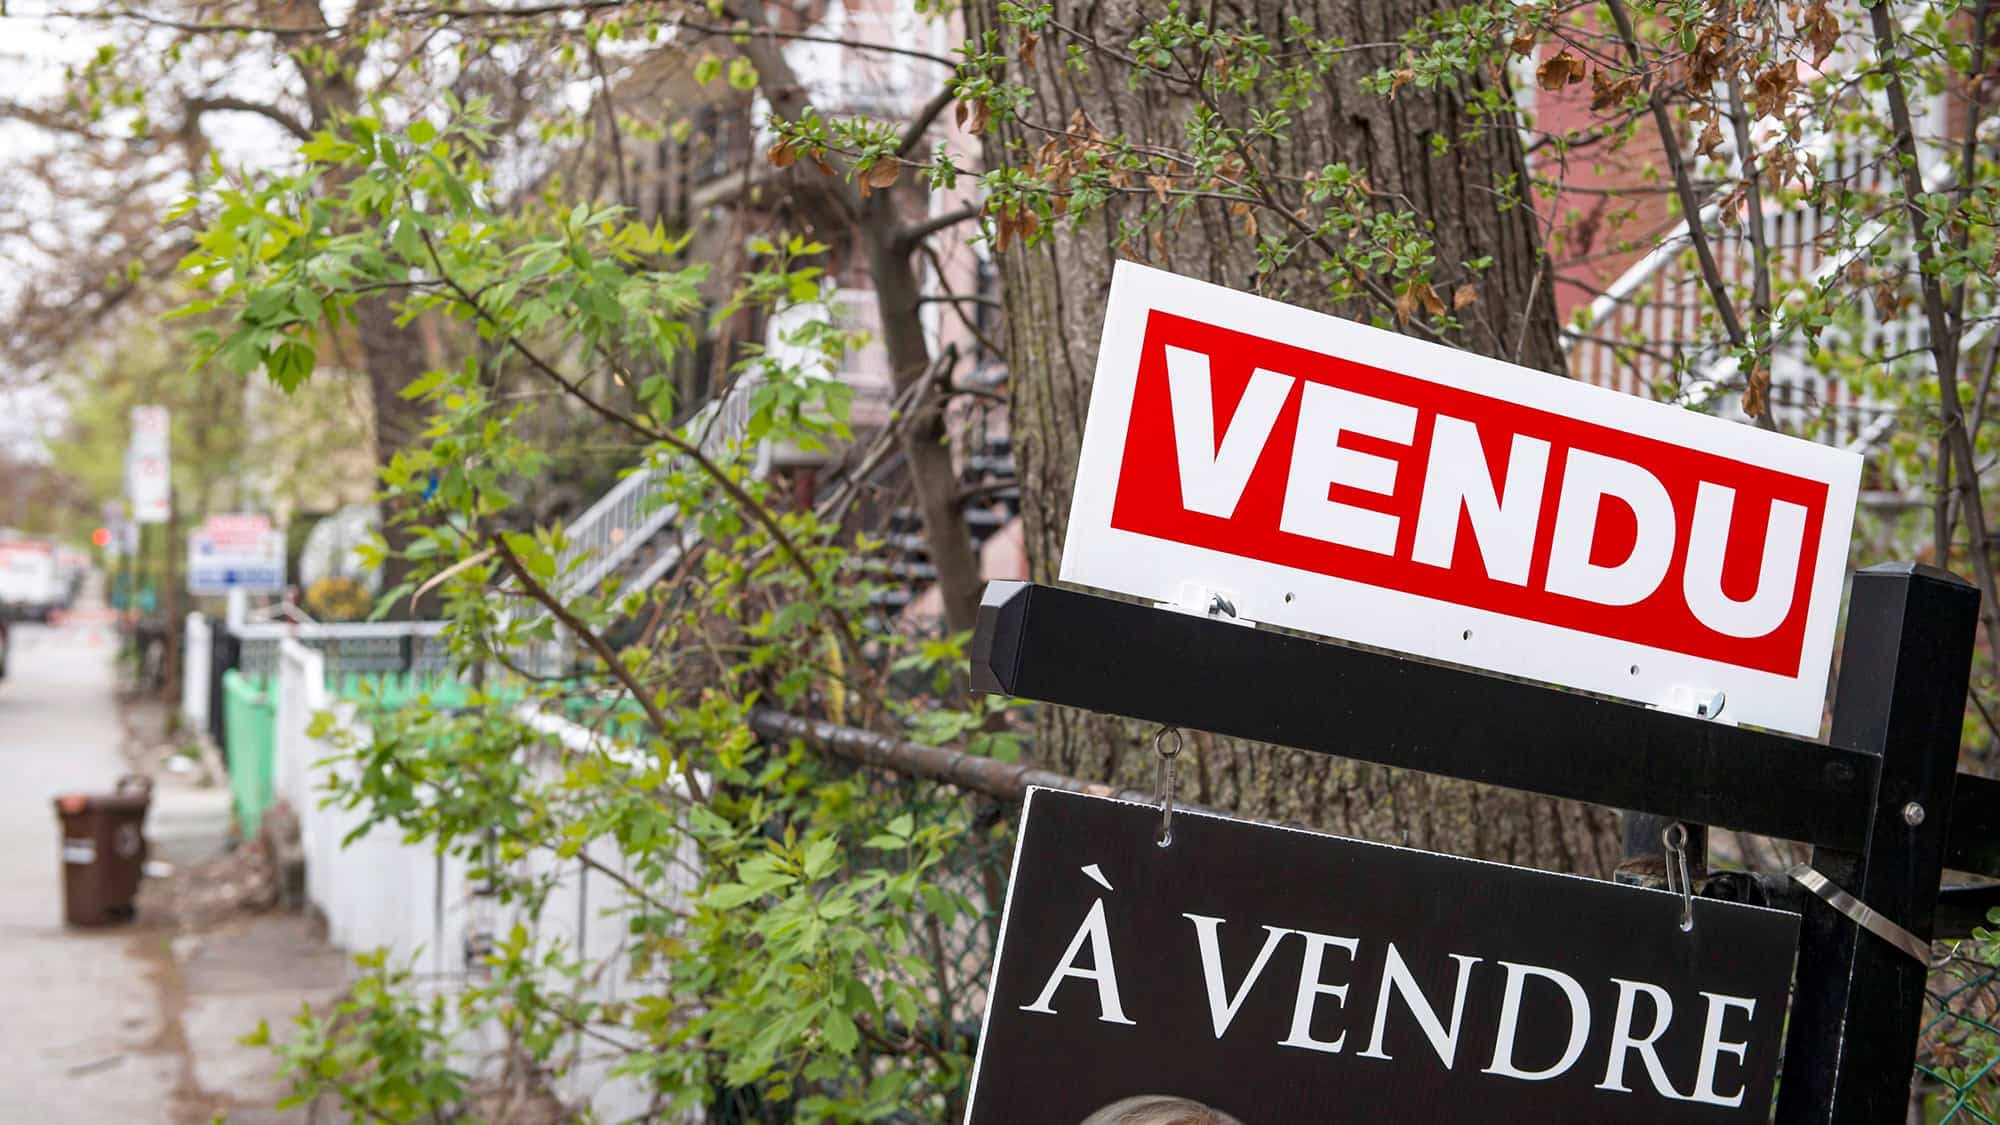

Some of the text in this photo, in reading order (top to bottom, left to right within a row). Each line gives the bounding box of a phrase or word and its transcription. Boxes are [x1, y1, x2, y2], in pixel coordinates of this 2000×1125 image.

[1165, 344, 1808, 638] VENDU
[1019, 864, 1757, 1108] À VENDRE
